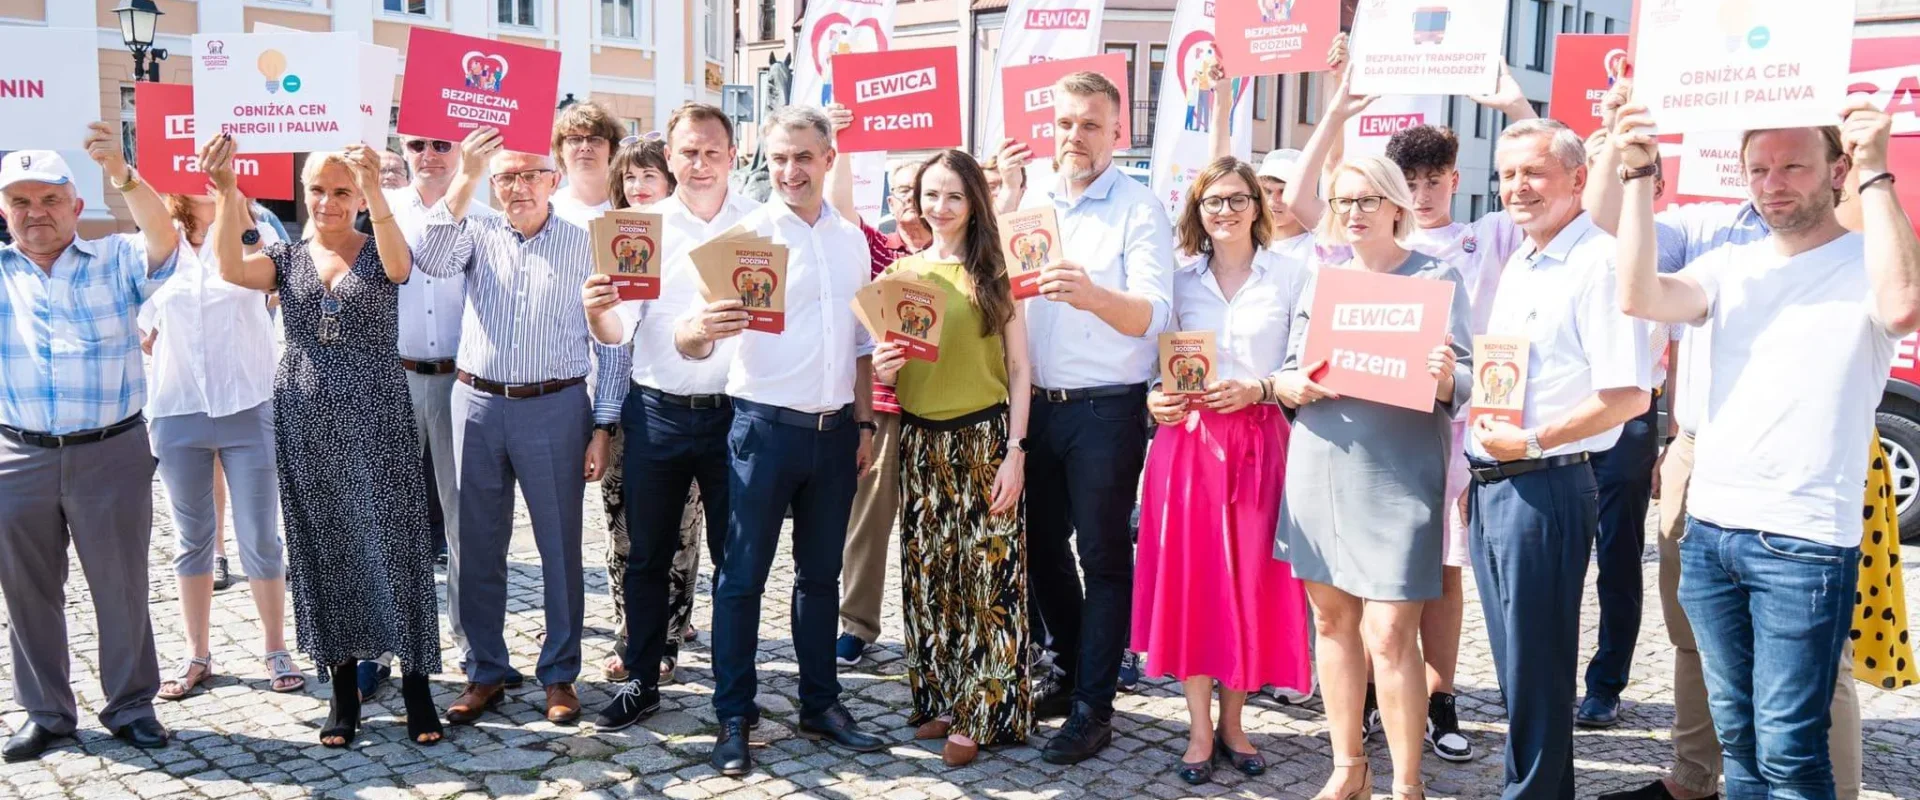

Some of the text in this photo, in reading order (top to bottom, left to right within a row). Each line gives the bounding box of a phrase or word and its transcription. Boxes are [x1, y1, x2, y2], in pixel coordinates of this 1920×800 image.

[1029, 9, 1087, 27] LEWICA
[1245, 23, 1308, 38] BEZPIECZNA
[1252, 39, 1300, 51] RODZINA
[1366, 53, 1487, 62] BEZPŁATNY TRANSPORT
[1365, 67, 1384, 75] DLA
[1680, 63, 1800, 86] OBNIŻKA CEN
[861, 72, 932, 99] LEWICA
[442, 88, 518, 110] BEZPIECZNA
[1662, 85, 1815, 109] ENERGII I PALIWA
[233, 102, 326, 117] OBNIŻKA CEN
[450, 105, 507, 123] RODZINA
[221, 121, 339, 134] ENERGII I PALIWA
[863, 112, 933, 131] razem
[1363, 116, 1418, 132] LEWICA
[1700, 148, 1738, 160] WALKA
[1338, 308, 1415, 326] LEWICA
[1331, 348, 1406, 379] razem
